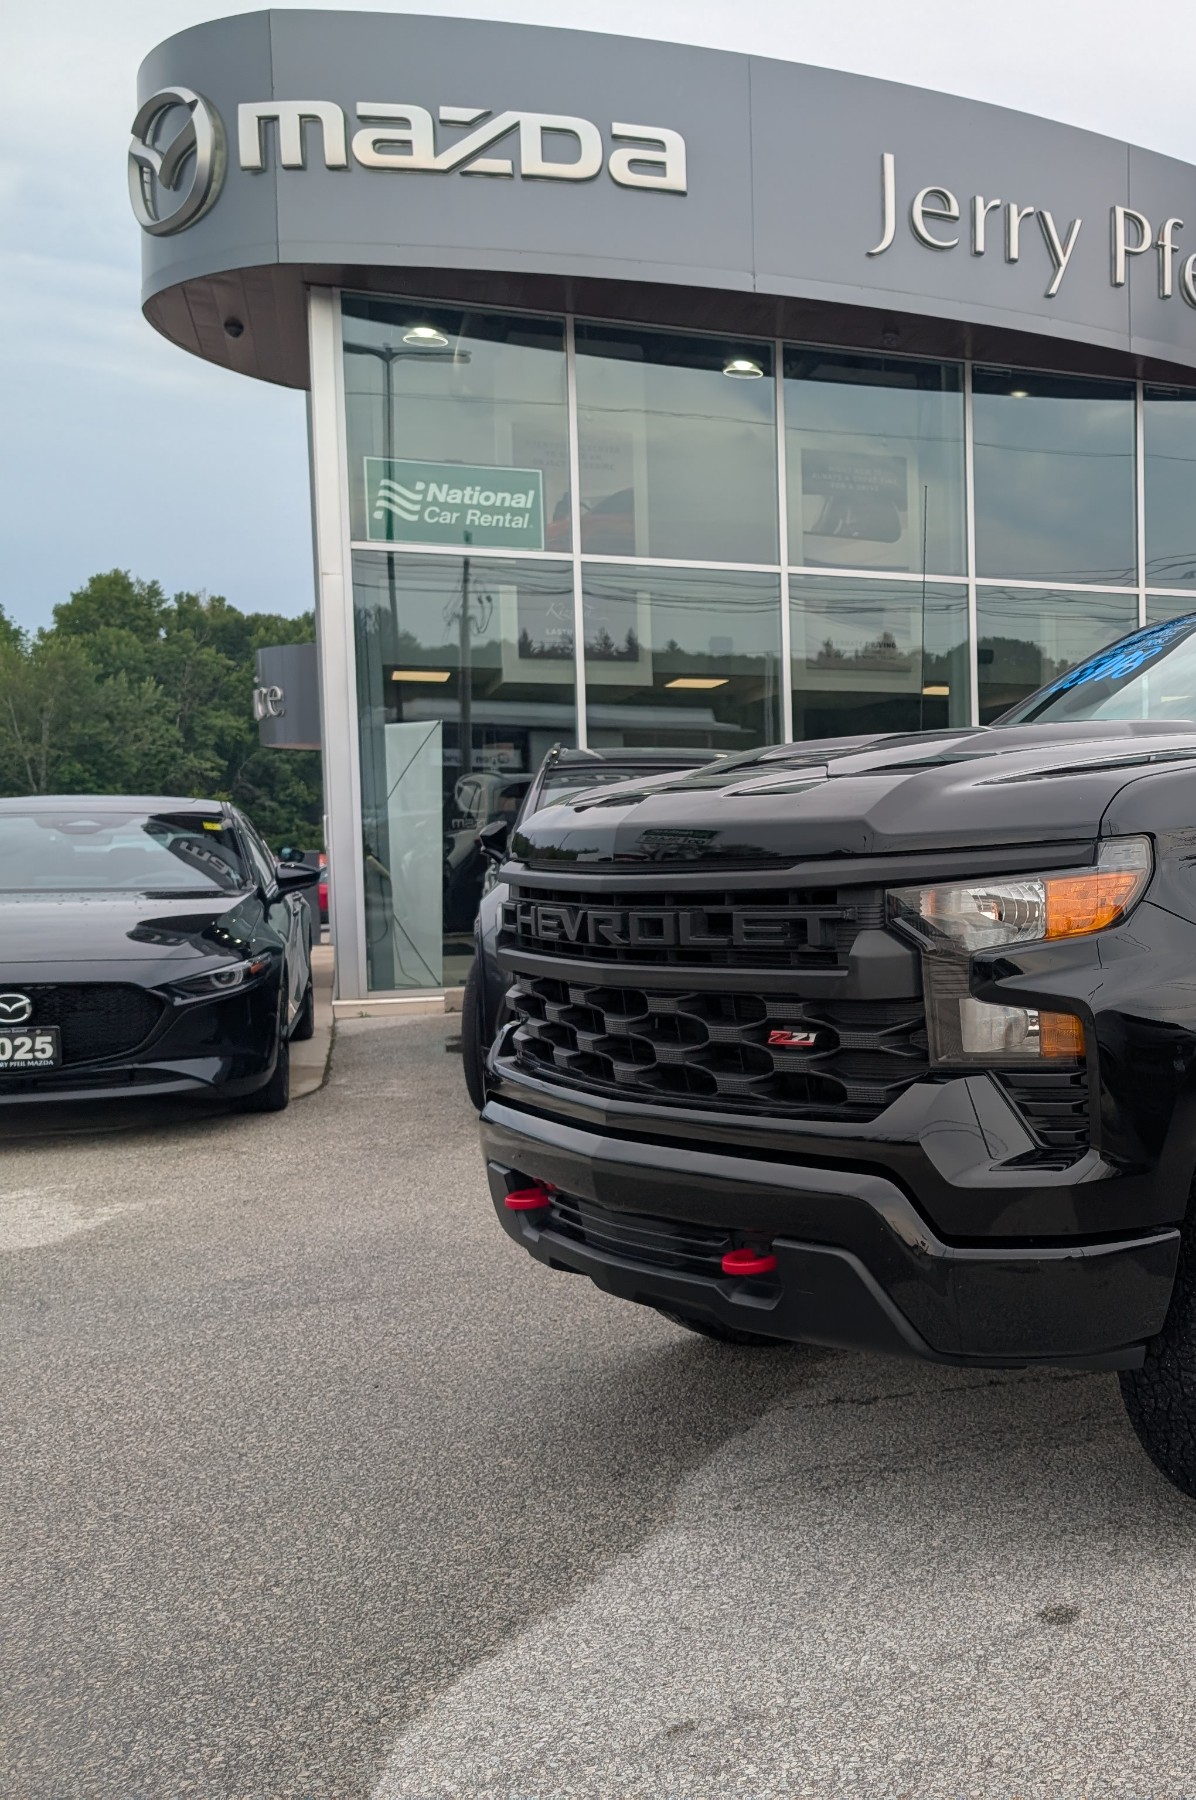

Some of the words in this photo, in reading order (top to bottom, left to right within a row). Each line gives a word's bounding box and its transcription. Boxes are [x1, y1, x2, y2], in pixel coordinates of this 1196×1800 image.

[238, 100, 688, 196] mazda
[866, 152, 1082, 298] Jerry
[427, 482, 535, 509] National
[424, 506, 460, 525] Car
[466, 509, 530, 529] Rental
[501, 900, 850, 947] CHEVROLET
[768, 1030, 817, 1046] Z71
